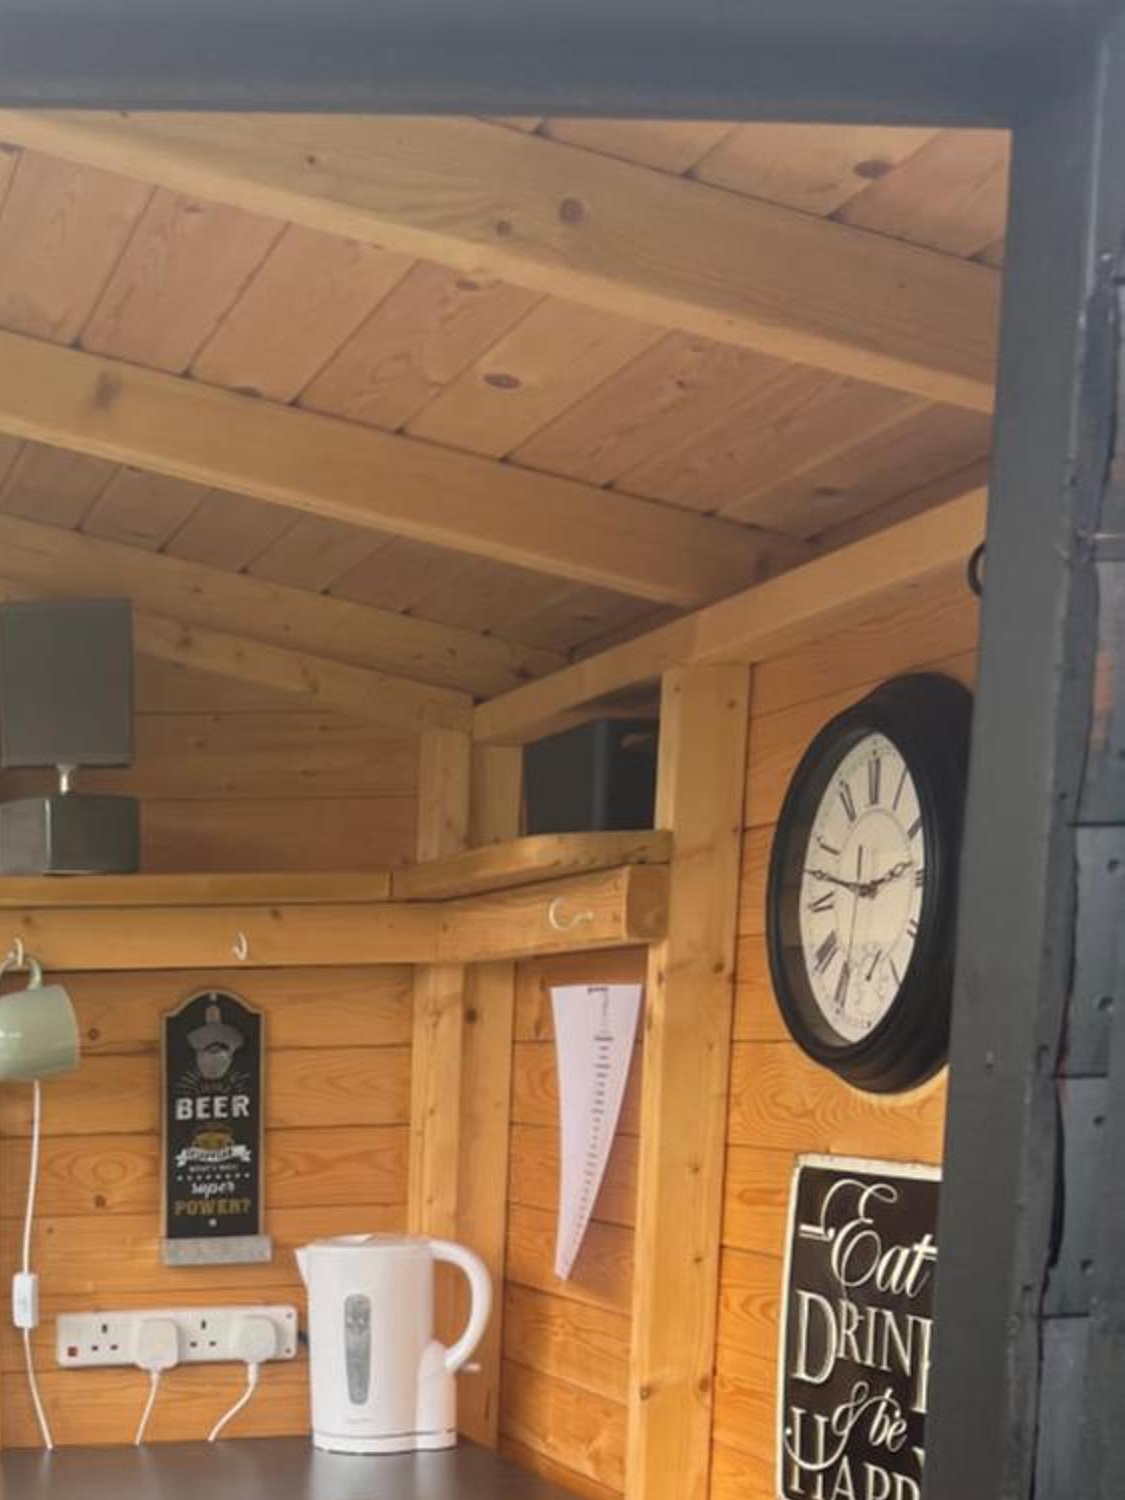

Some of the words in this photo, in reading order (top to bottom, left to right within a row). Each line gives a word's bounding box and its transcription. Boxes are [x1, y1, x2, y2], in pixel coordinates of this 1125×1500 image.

[176, 1095, 251, 1120] BEER
[820, 1179, 936, 1299] Eat
[869, 1387, 908, 1453] be
